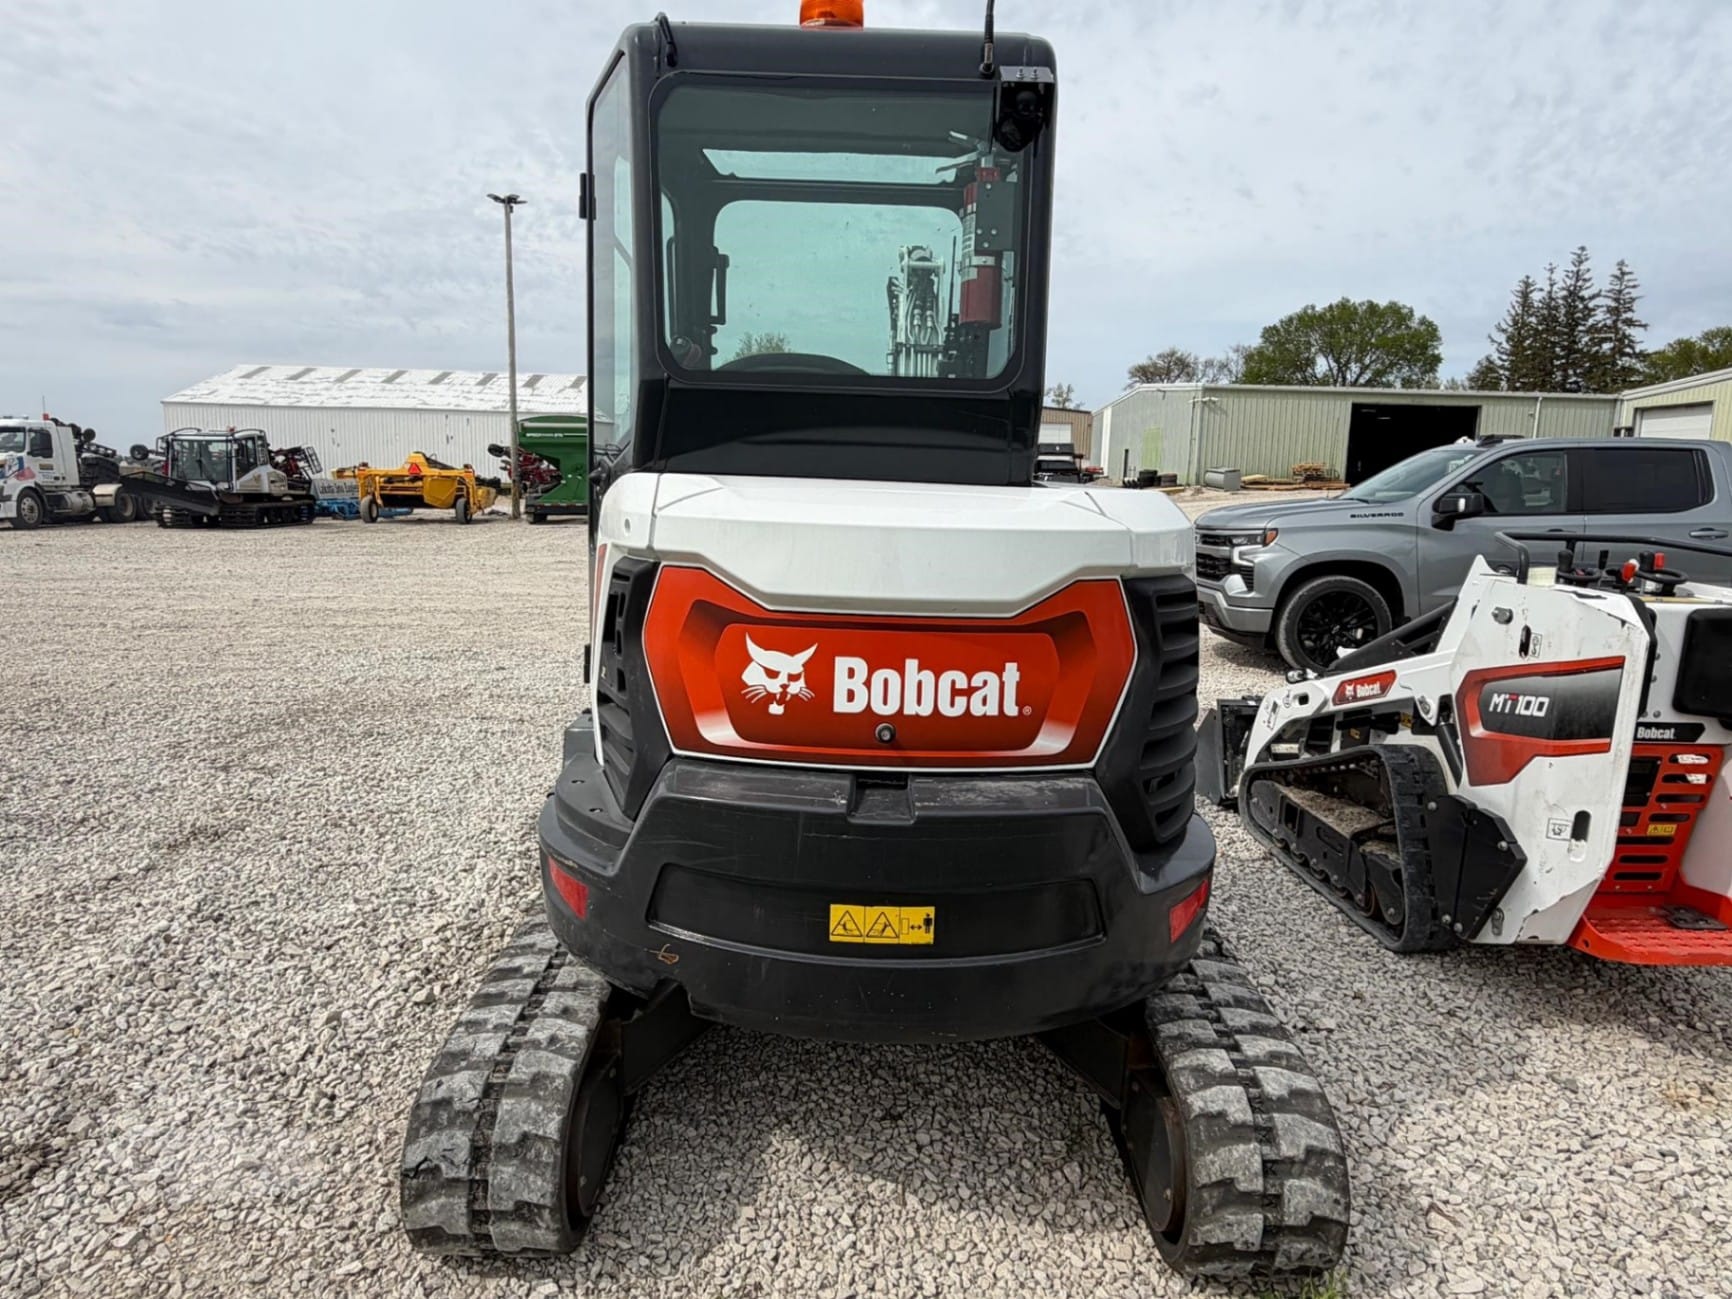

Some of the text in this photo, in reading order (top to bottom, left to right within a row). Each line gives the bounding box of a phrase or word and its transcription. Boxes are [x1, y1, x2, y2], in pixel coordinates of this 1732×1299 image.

[833, 656, 1020, 717] Bobcat
[1356, 680, 1381, 698] Bobcat
[1489, 693, 1549, 717] MT100
[1637, 727, 1675, 740] Bobcat
